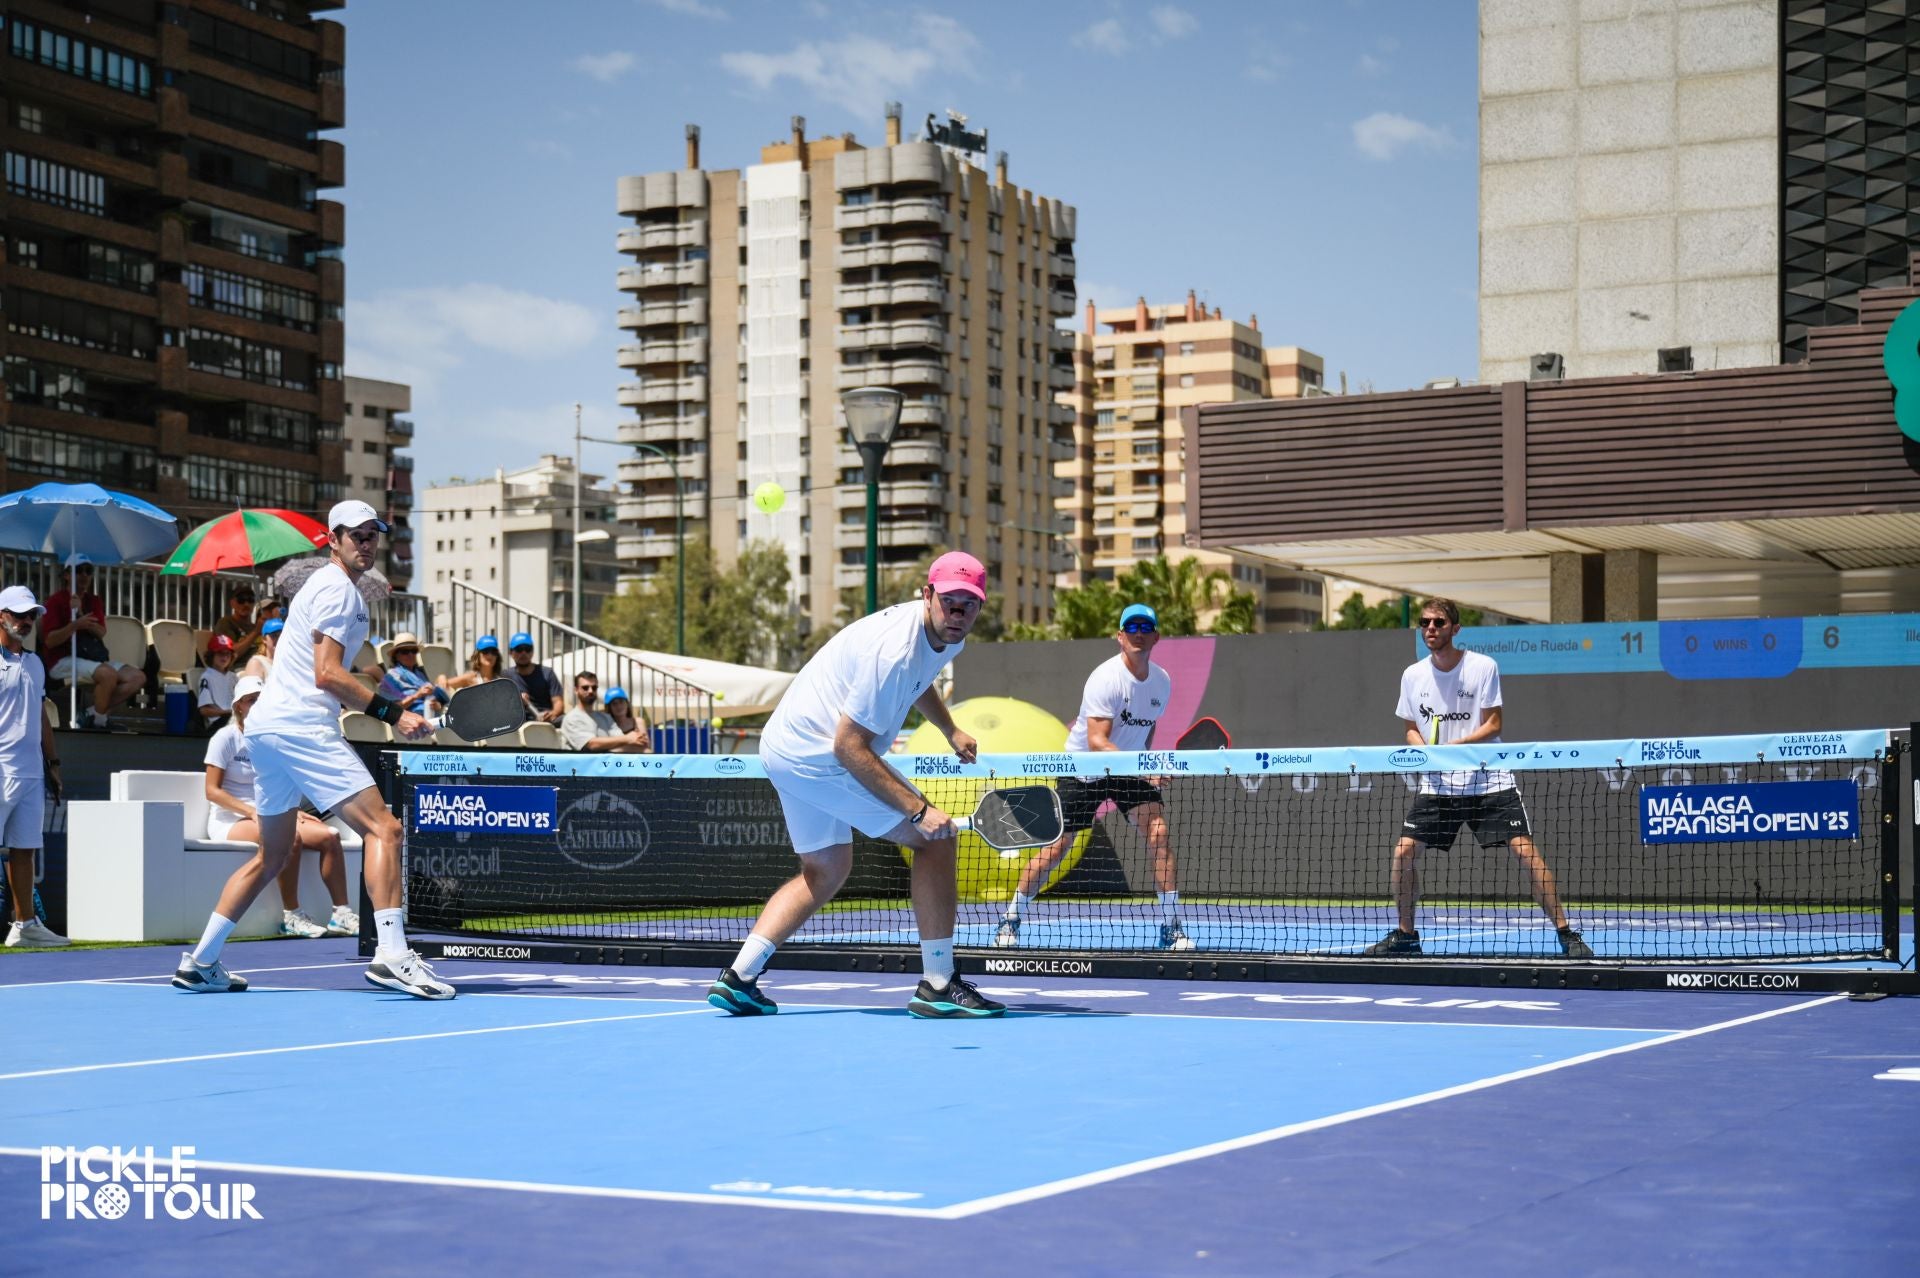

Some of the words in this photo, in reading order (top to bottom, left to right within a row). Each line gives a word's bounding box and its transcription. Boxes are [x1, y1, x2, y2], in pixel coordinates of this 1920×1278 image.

[1620, 631, 1643, 654] 11
[1685, 635, 1699, 653] 0
[1713, 638, 1749, 651] WINS
[1762, 633, 1777, 651] 0
[1823, 625, 1840, 649] 6
[1540, 638, 1580, 652] Rueda
[1641, 740, 1684, 751] PICKLE
[1783, 734, 1843, 744] CERVEZAS
[1138, 752, 1175, 762] PICKLE
[1498, 749, 1580, 761] VOLVO
[1778, 744, 1847, 757] VICTORIA
[515, 755, 545, 764] PICKLE
[915, 756, 949, 766] PICKLE
[1026, 753, 1073, 762] CERVEZAS
[1271, 754, 1312, 767] picklebull
[423, 762, 468, 772] VICTORIA
[602, 761, 663, 769] VOLVO
[1022, 763, 1077, 773] VICTORIA
[419, 790, 487, 812] MÁLAGA
[1647, 792, 1754, 817] MÁLAGA
[419, 810, 484, 827] SPANISH
[485, 811, 530, 829] OPEN
[1648, 815, 1750, 836] SPANISH
[1752, 811, 1819, 833] OPEN
[443, 945, 531, 959] NOXPICKLE.COM
[985, 959, 1093, 974] NOXPICKLE.COM
[1666, 973, 1799, 988] NOXPICKLE.COM
